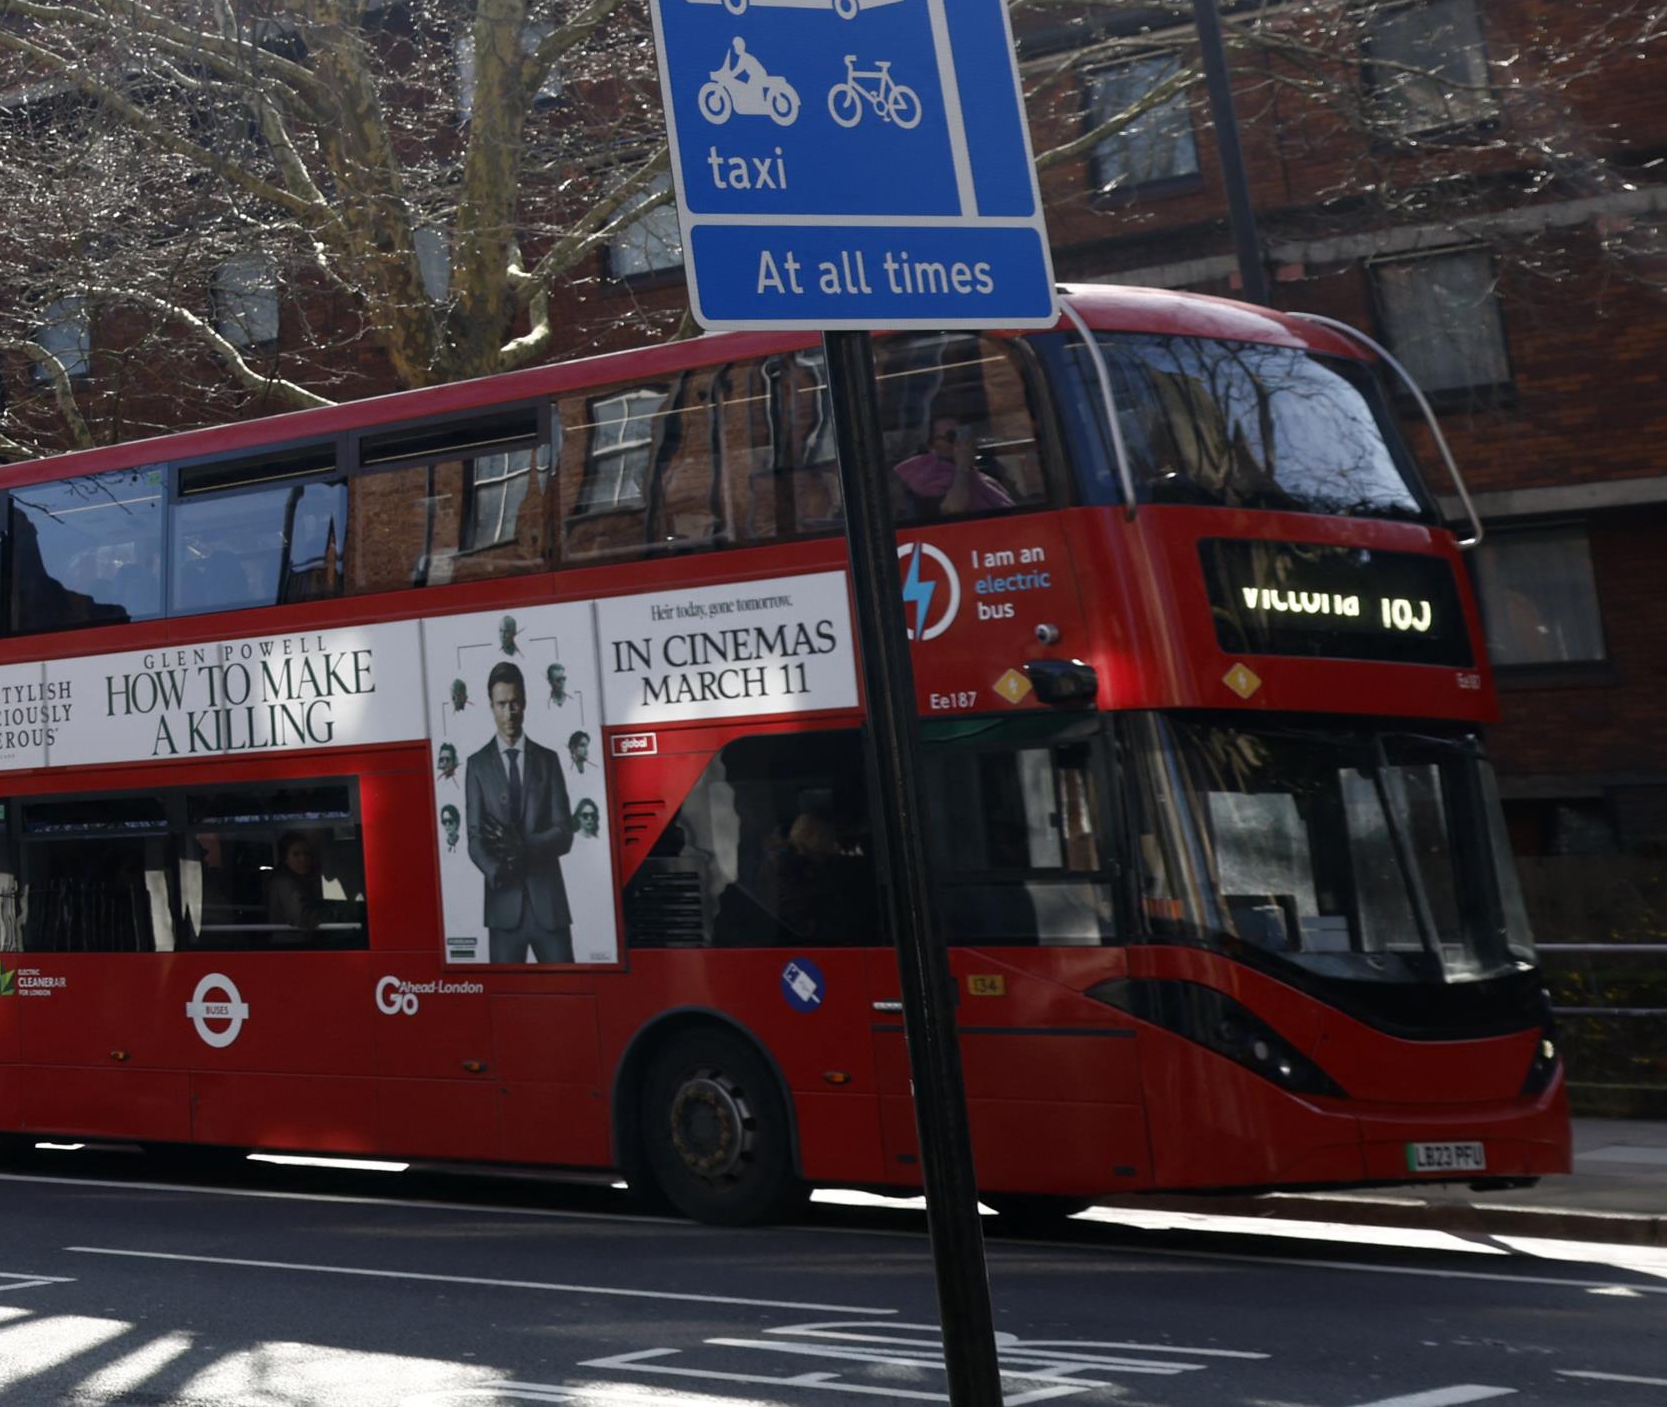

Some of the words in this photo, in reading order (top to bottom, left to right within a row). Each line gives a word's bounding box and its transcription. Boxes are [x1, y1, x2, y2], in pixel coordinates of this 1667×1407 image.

[708, 146, 787, 189] taxi
[757, 250, 803, 294] At
[819, 250, 872, 294] all
[883, 251, 994, 294] times
[971, 550, 979, 569] I
[984, 551, 1015, 567] am
[1020, 547, 1045, 563] an
[975, 569, 1051, 594] electric
[650, 603, 674, 621] Heir
[709, 601, 735, 619] gone
[977, 601, 1015, 620] bus
[144, 649, 205, 669] GLEN
[225, 636, 327, 661] POWELL
[612, 638, 653, 673] IN
[663, 619, 837, 667] CINEMAS
[105, 668, 189, 716] HOW
[198, 663, 251, 707] TO
[260, 649, 376, 702] MAKE
[641, 666, 769, 706] MARCH
[780, 662, 812, 695] 11
[930, 691, 977, 709] Ee187
[152, 714, 178, 756] A
[187, 700, 335, 753] KILLING
[620, 737, 648, 752] global
[375, 975, 419, 1015] Go
